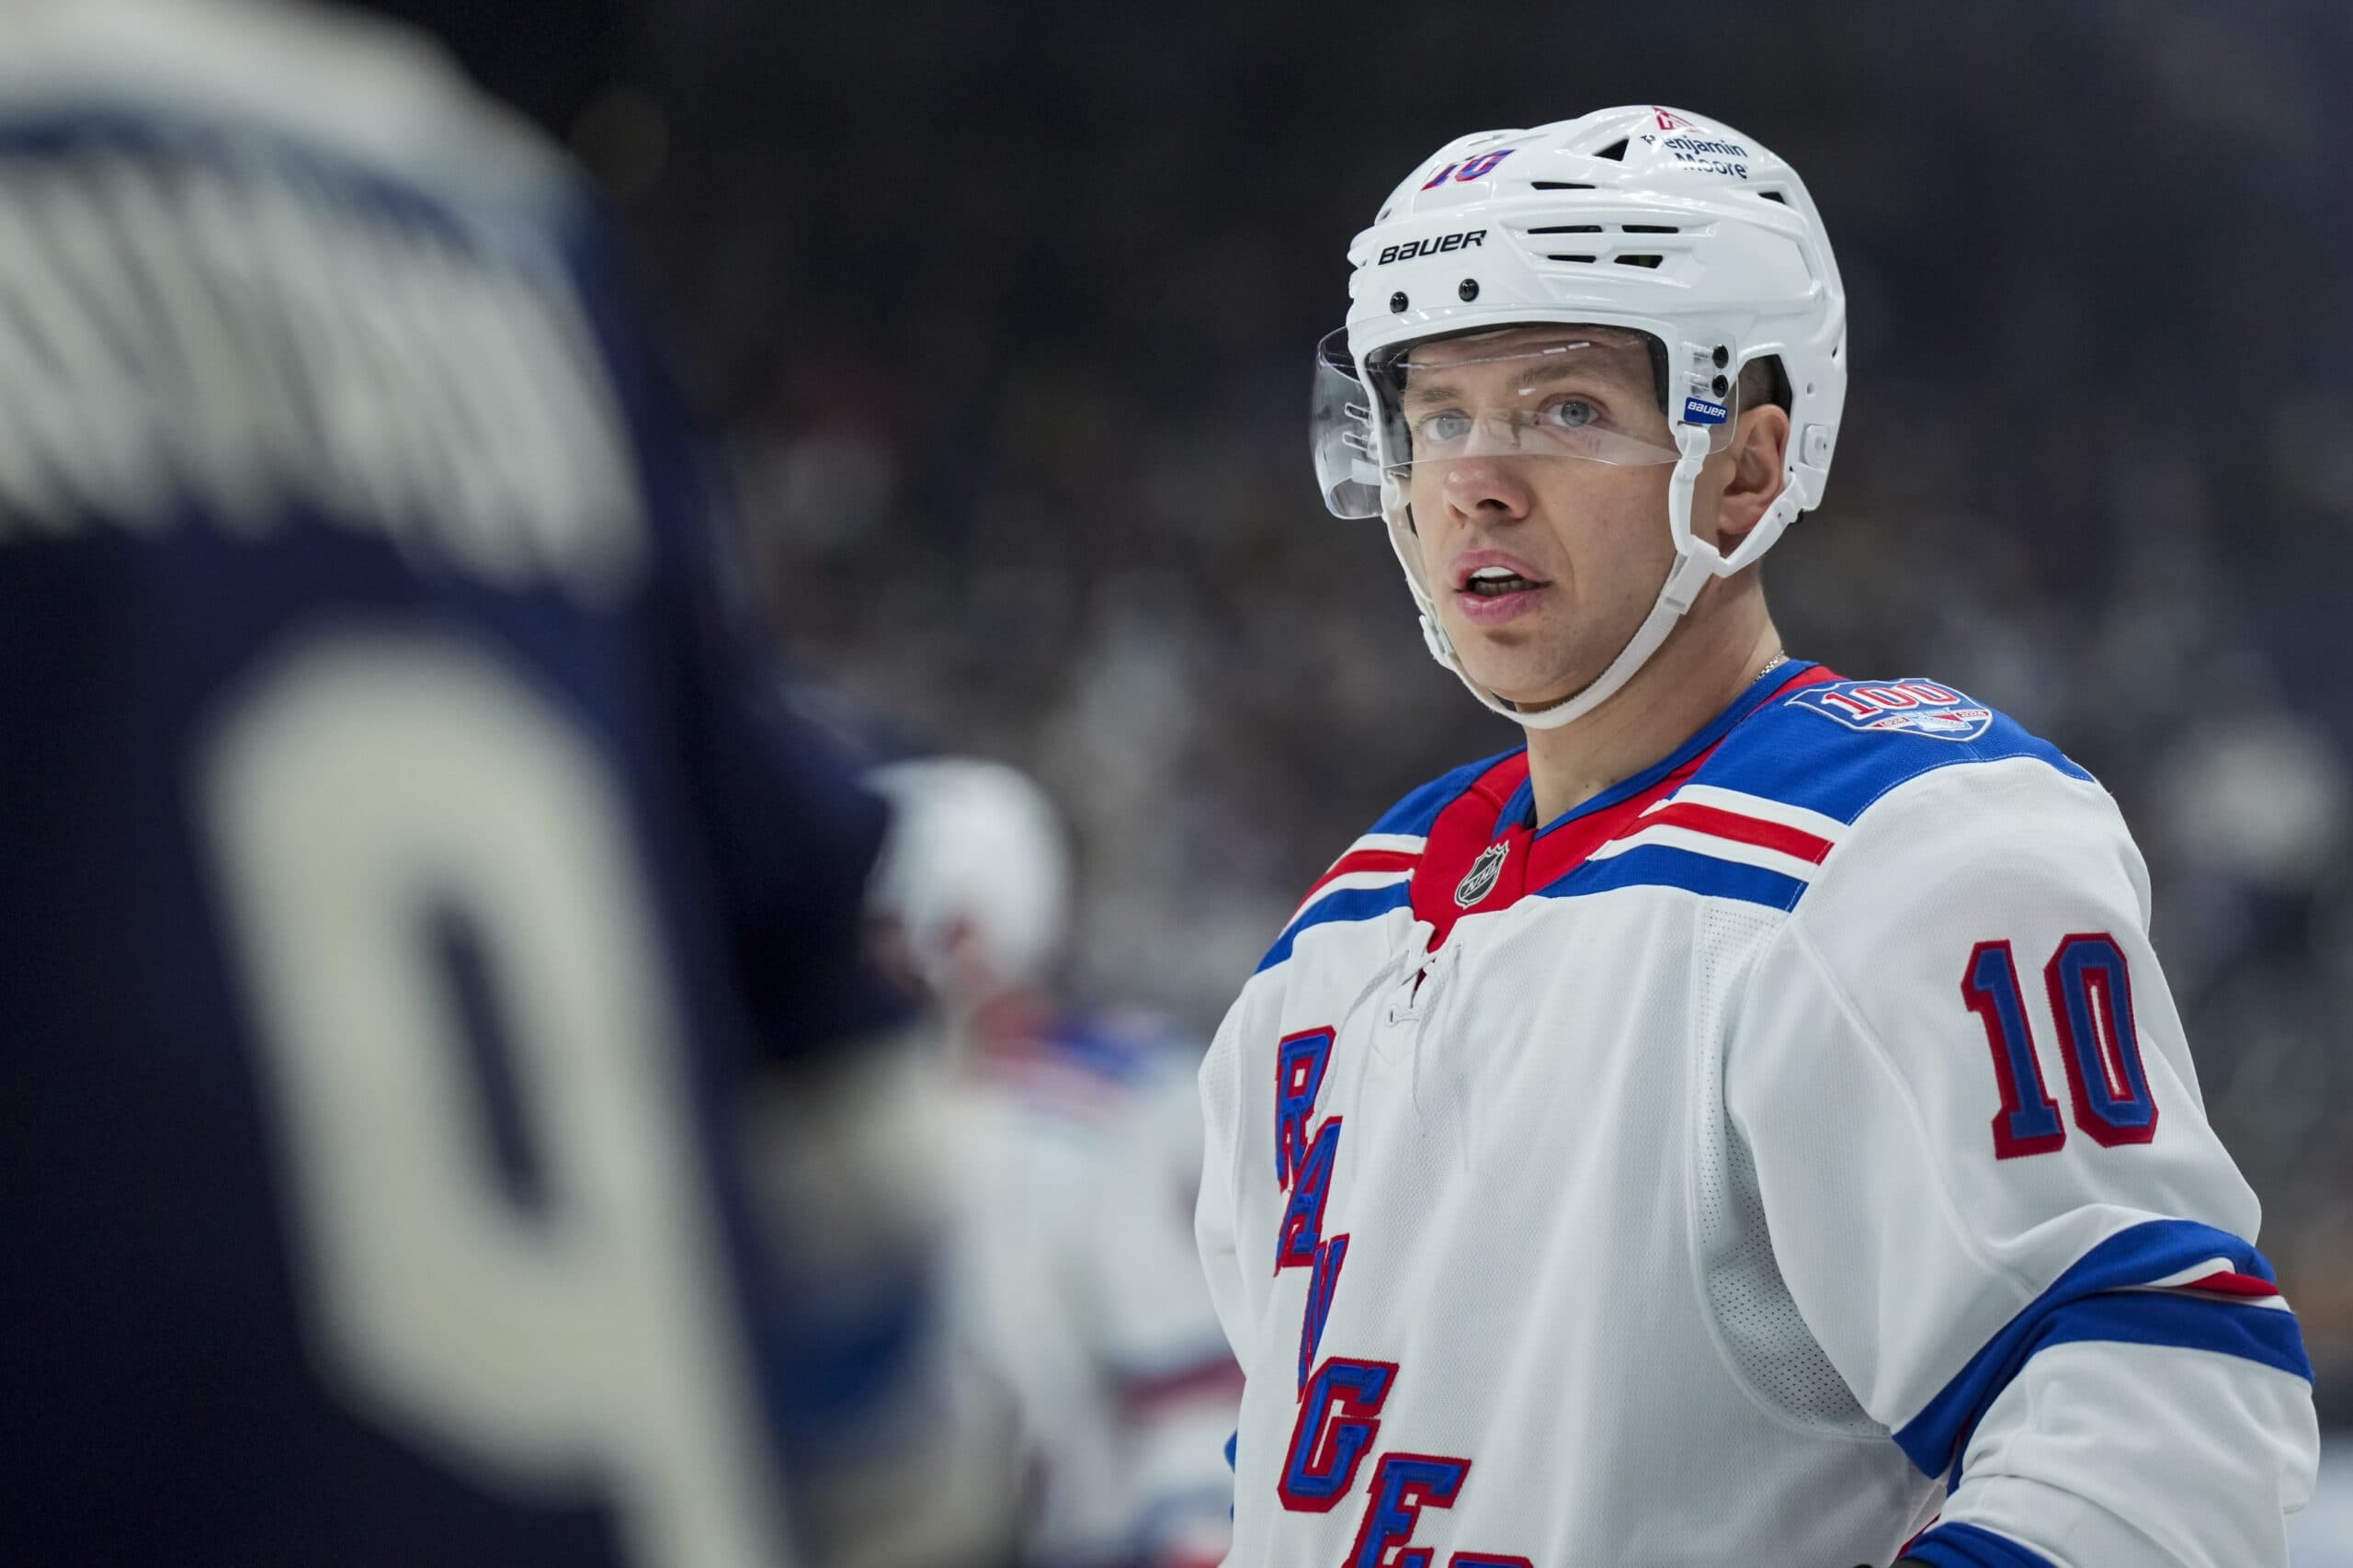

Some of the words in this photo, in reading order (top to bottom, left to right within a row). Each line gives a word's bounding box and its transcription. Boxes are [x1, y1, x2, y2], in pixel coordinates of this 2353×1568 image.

[1420, 148, 1517, 191] 10
[1378, 229, 1487, 266] BAUER
[1688, 401, 1726, 418] BAUER
[1821, 683, 1961, 721] 100
[1961, 932, 2159, 1160] 10
[1274, 1025, 1534, 1568] RANGE
